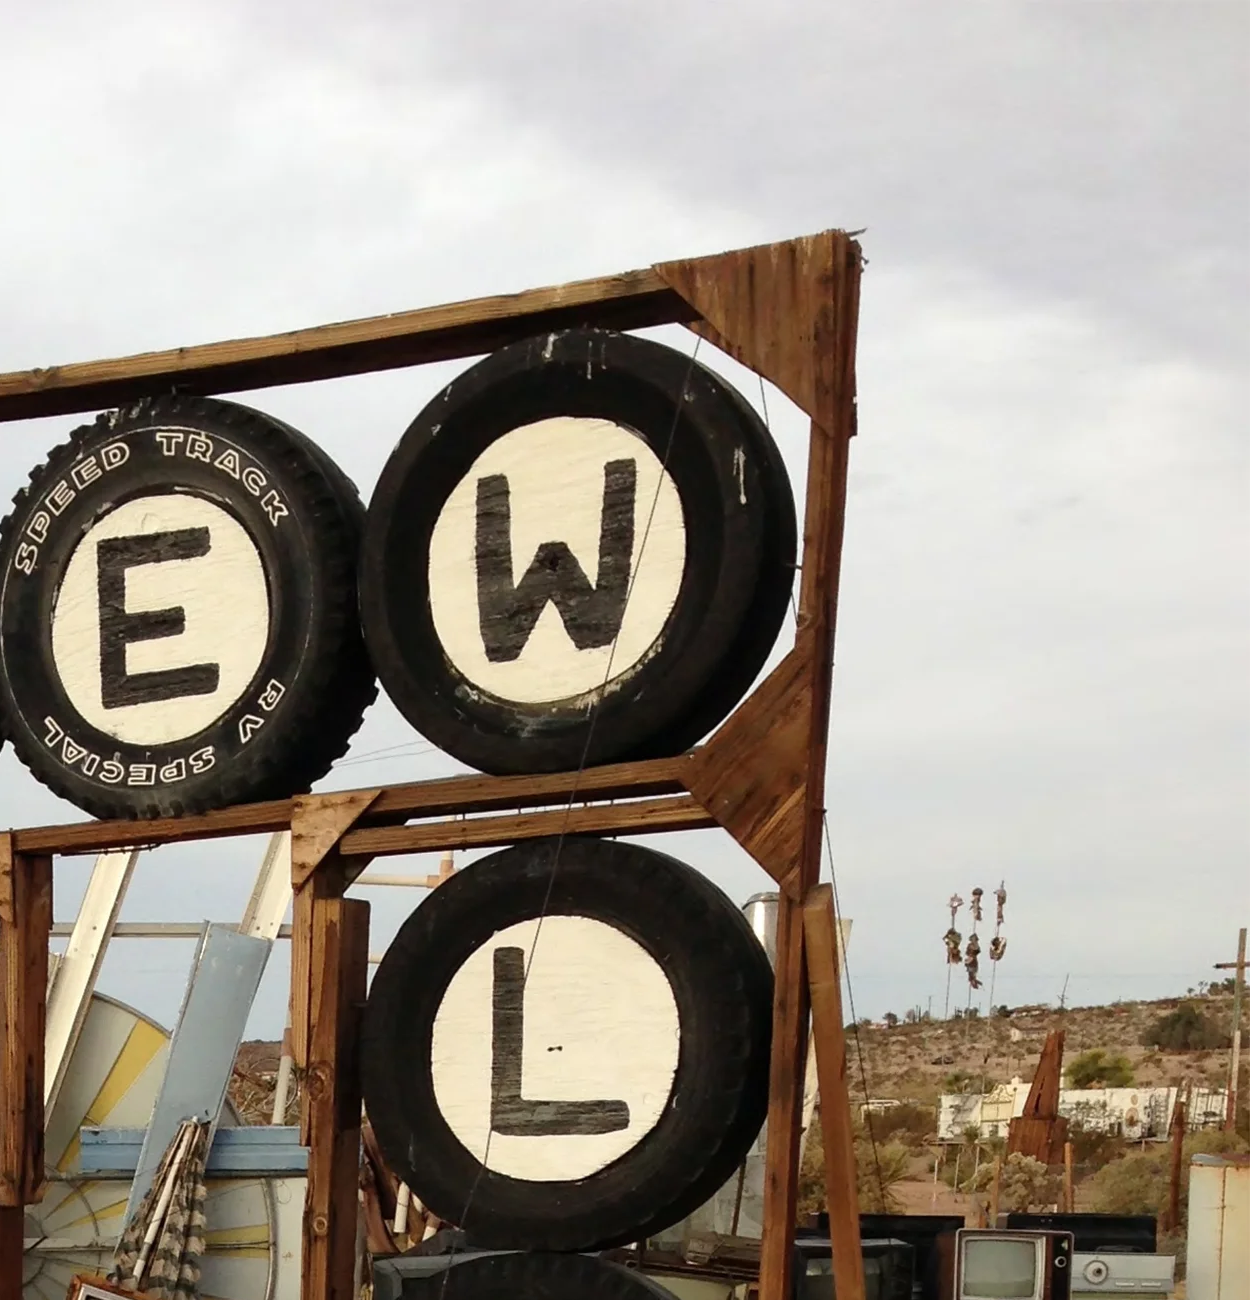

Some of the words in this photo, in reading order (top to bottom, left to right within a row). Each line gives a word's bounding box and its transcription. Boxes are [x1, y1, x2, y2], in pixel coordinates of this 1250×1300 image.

[14, 441, 131, 575] SPEED
[155, 431, 290, 528] TRACK
[475, 457, 637, 663] W
[96, 526, 221, 710] E
[43, 715, 217, 786] SPECIAL
[238, 677, 286, 744] RV
[490, 946, 630, 1136] L
